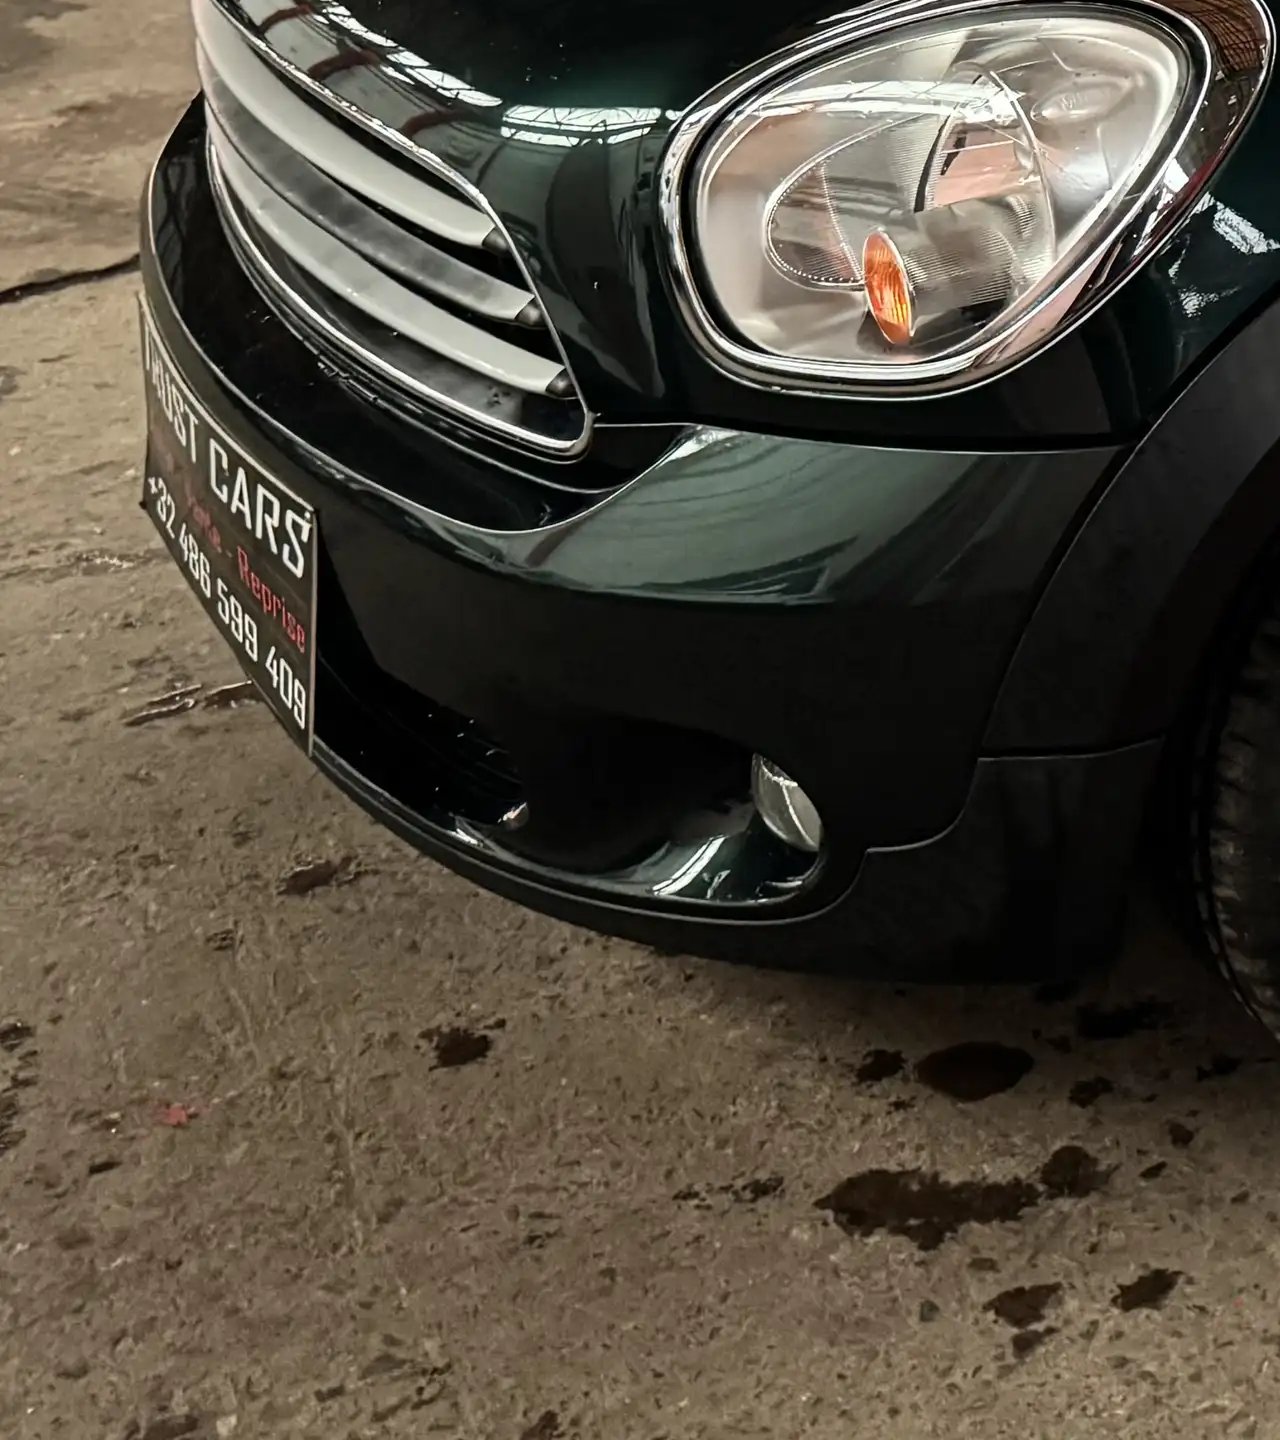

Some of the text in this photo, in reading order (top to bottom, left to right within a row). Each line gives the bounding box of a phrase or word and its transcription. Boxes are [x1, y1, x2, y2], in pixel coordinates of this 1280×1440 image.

[144, 321, 199, 464] TRUST
[208, 438, 312, 579] CARS
[179, 523, 212, 598] 486
[217, 576, 259, 664] 599
[265, 646, 307, 730] 409
[236, 544, 307, 654] Reprise
